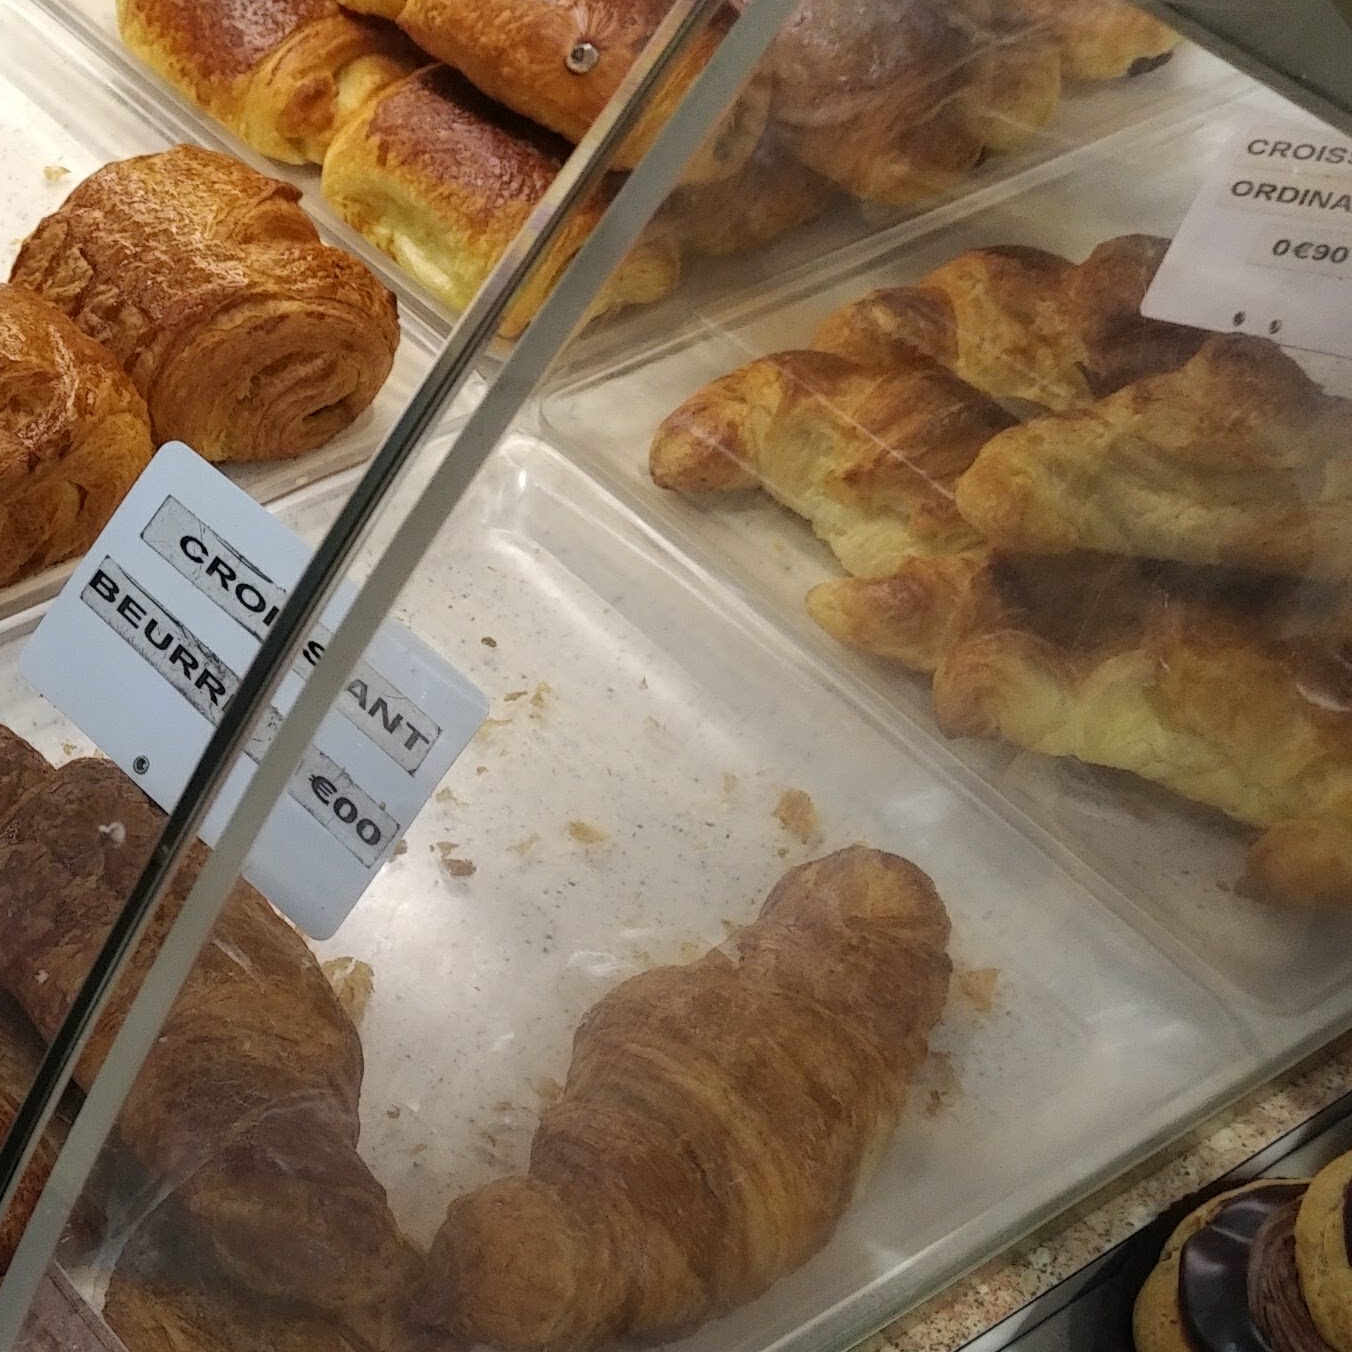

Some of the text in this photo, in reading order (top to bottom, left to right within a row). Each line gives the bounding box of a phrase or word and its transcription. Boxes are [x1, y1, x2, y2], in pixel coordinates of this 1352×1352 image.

[1247, 139, 1352, 165] CROIS
[1272, 239, 1349, 264] 0€90
[87, 570, 382, 846] BEURR €00
